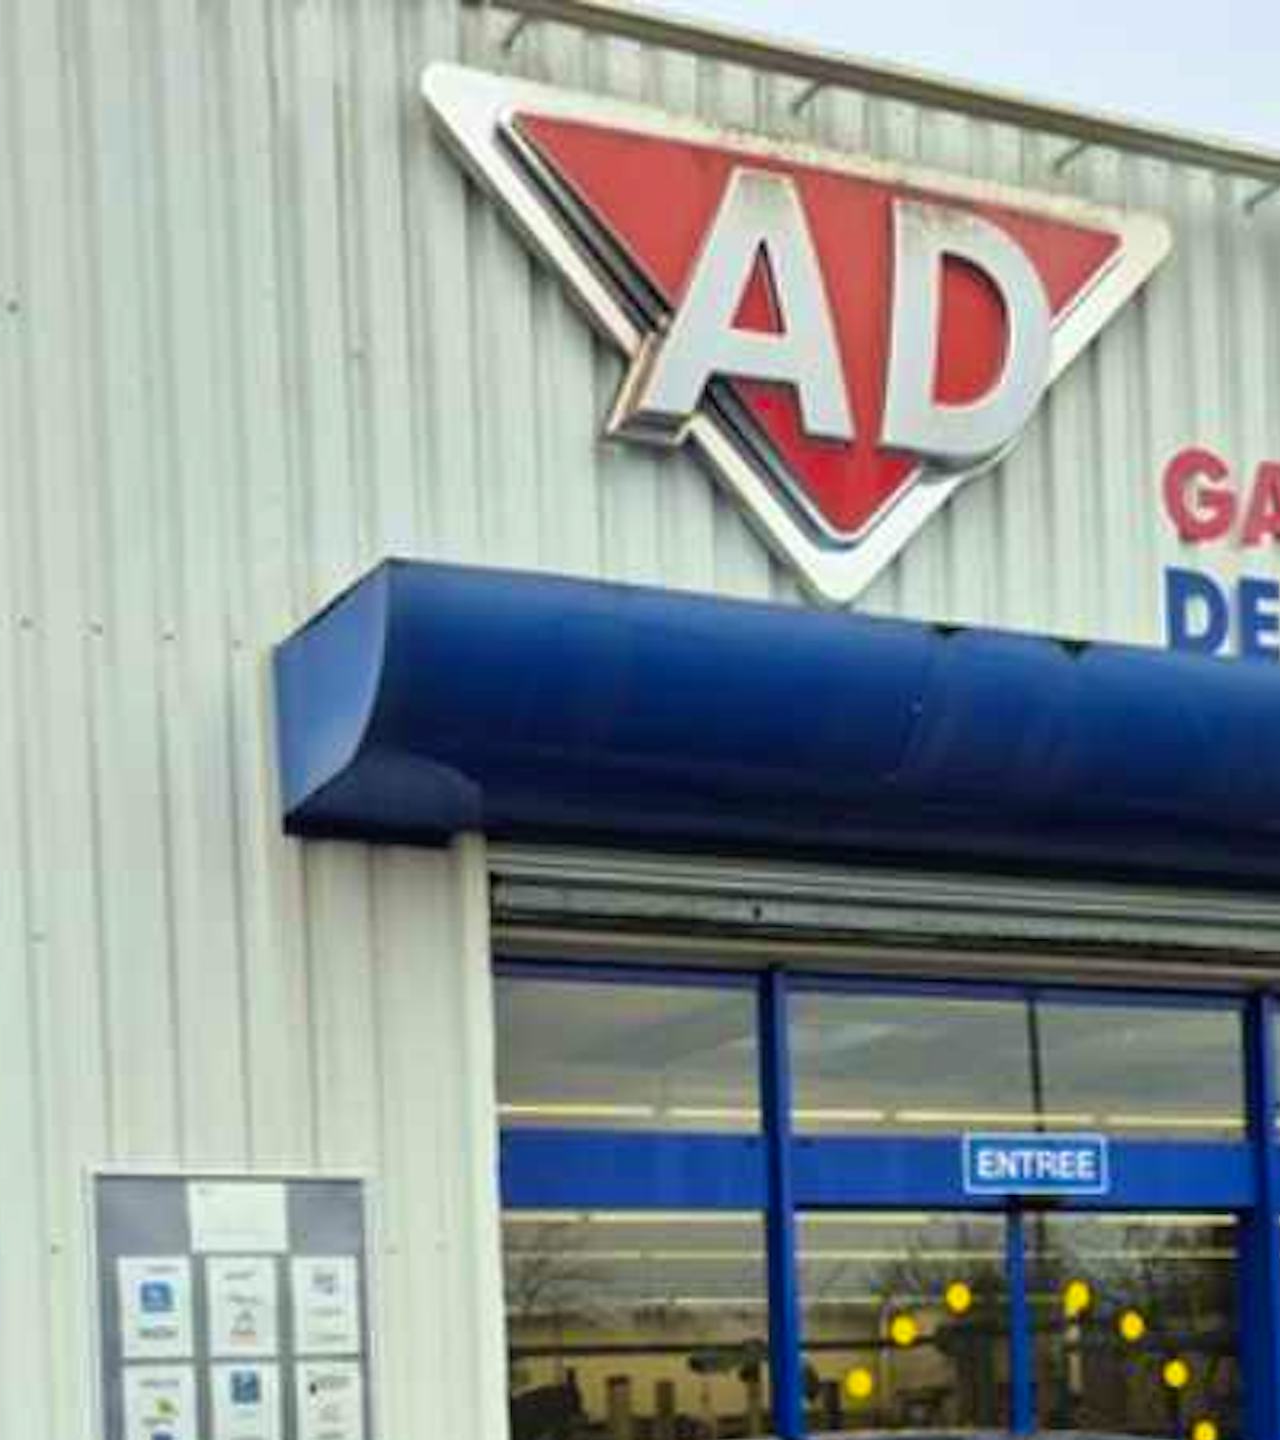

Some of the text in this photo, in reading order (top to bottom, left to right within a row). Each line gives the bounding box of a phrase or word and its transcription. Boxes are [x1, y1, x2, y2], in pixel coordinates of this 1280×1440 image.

[632, 166, 1054, 460] AD
[1165, 566, 1280, 662] DE
[977, 1149, 1098, 1179] ENTREE
